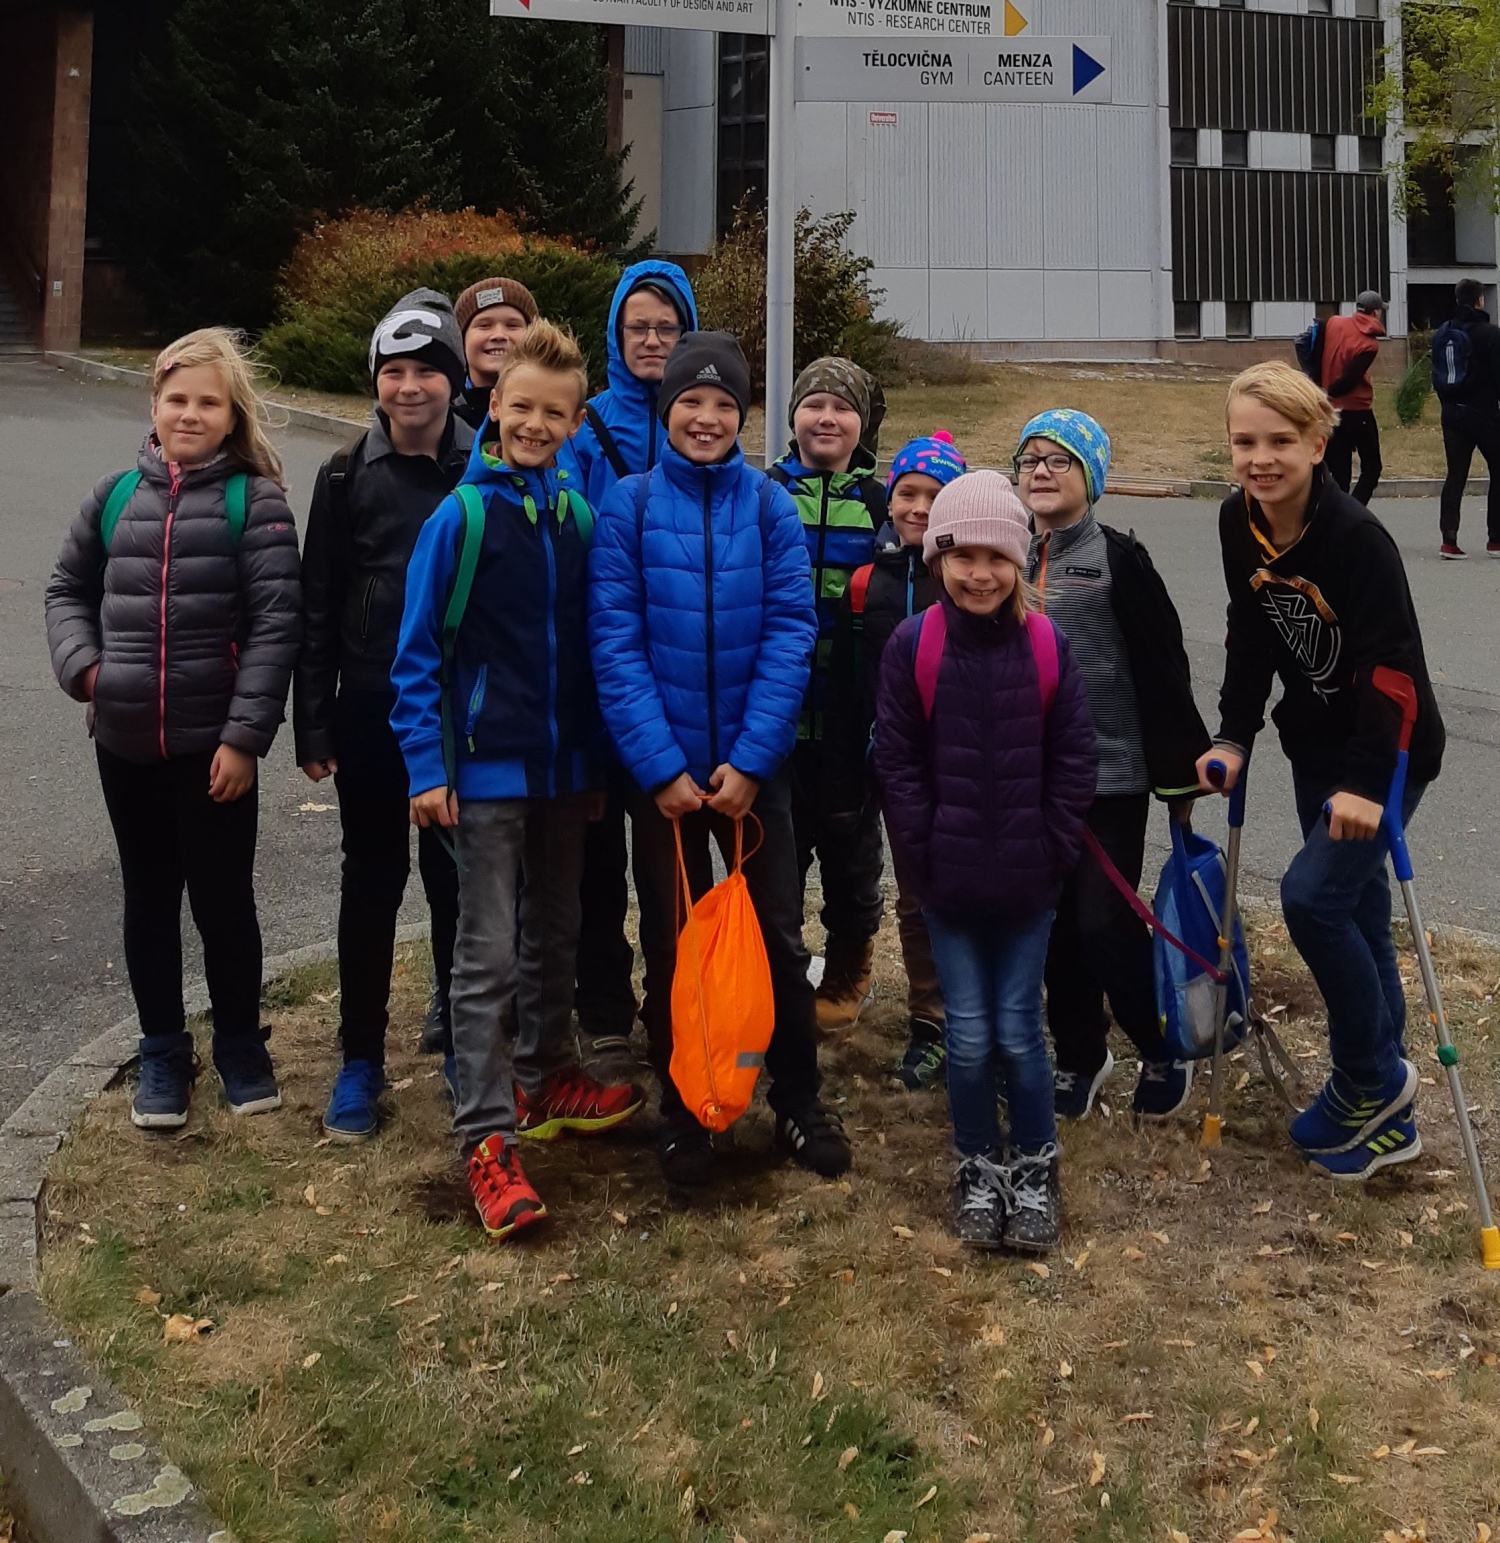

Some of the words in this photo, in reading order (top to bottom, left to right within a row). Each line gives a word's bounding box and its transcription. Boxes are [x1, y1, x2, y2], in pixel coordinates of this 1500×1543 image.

[716, 0, 734, 12] AND
[736, 2, 753, 14] ART
[936, 1, 991, 18] CENTRUM
[847, 11, 875, 26] NTIS
[886, 14, 944, 31] RESEARCH
[948, 19, 991, 35] CENTER
[862, 49, 953, 67] TĚLOCVIČNA
[998, 53, 1053, 68] MENZA
[920, 70, 954, 86] GYM
[983, 71, 1054, 86] CANTEEN
